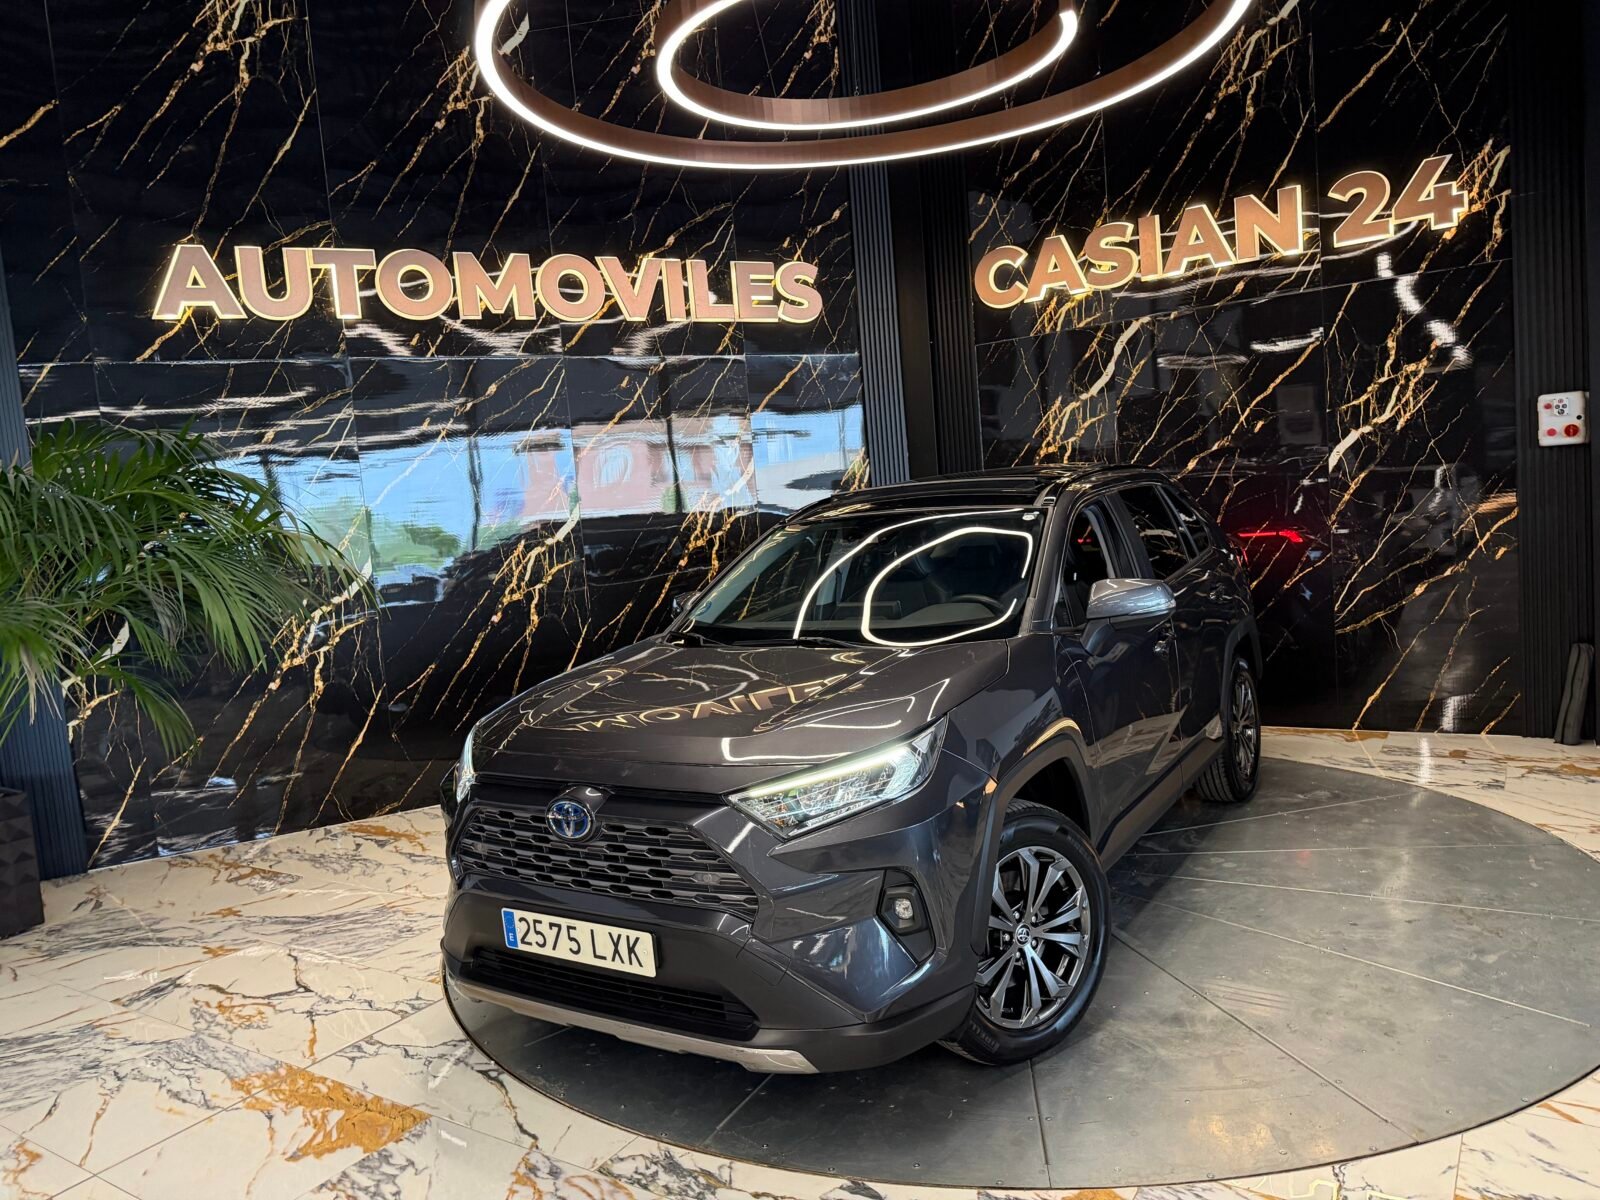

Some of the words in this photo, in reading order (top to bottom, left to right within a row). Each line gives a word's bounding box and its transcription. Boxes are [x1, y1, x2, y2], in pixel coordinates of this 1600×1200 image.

[974, 184, 1304, 309] CASIAN
[1326, 154, 1469, 249] 24
[152, 244, 824, 324] AUTOMOVILES
[518, 916, 581, 955] 2575
[590, 928, 644, 968] LXK
